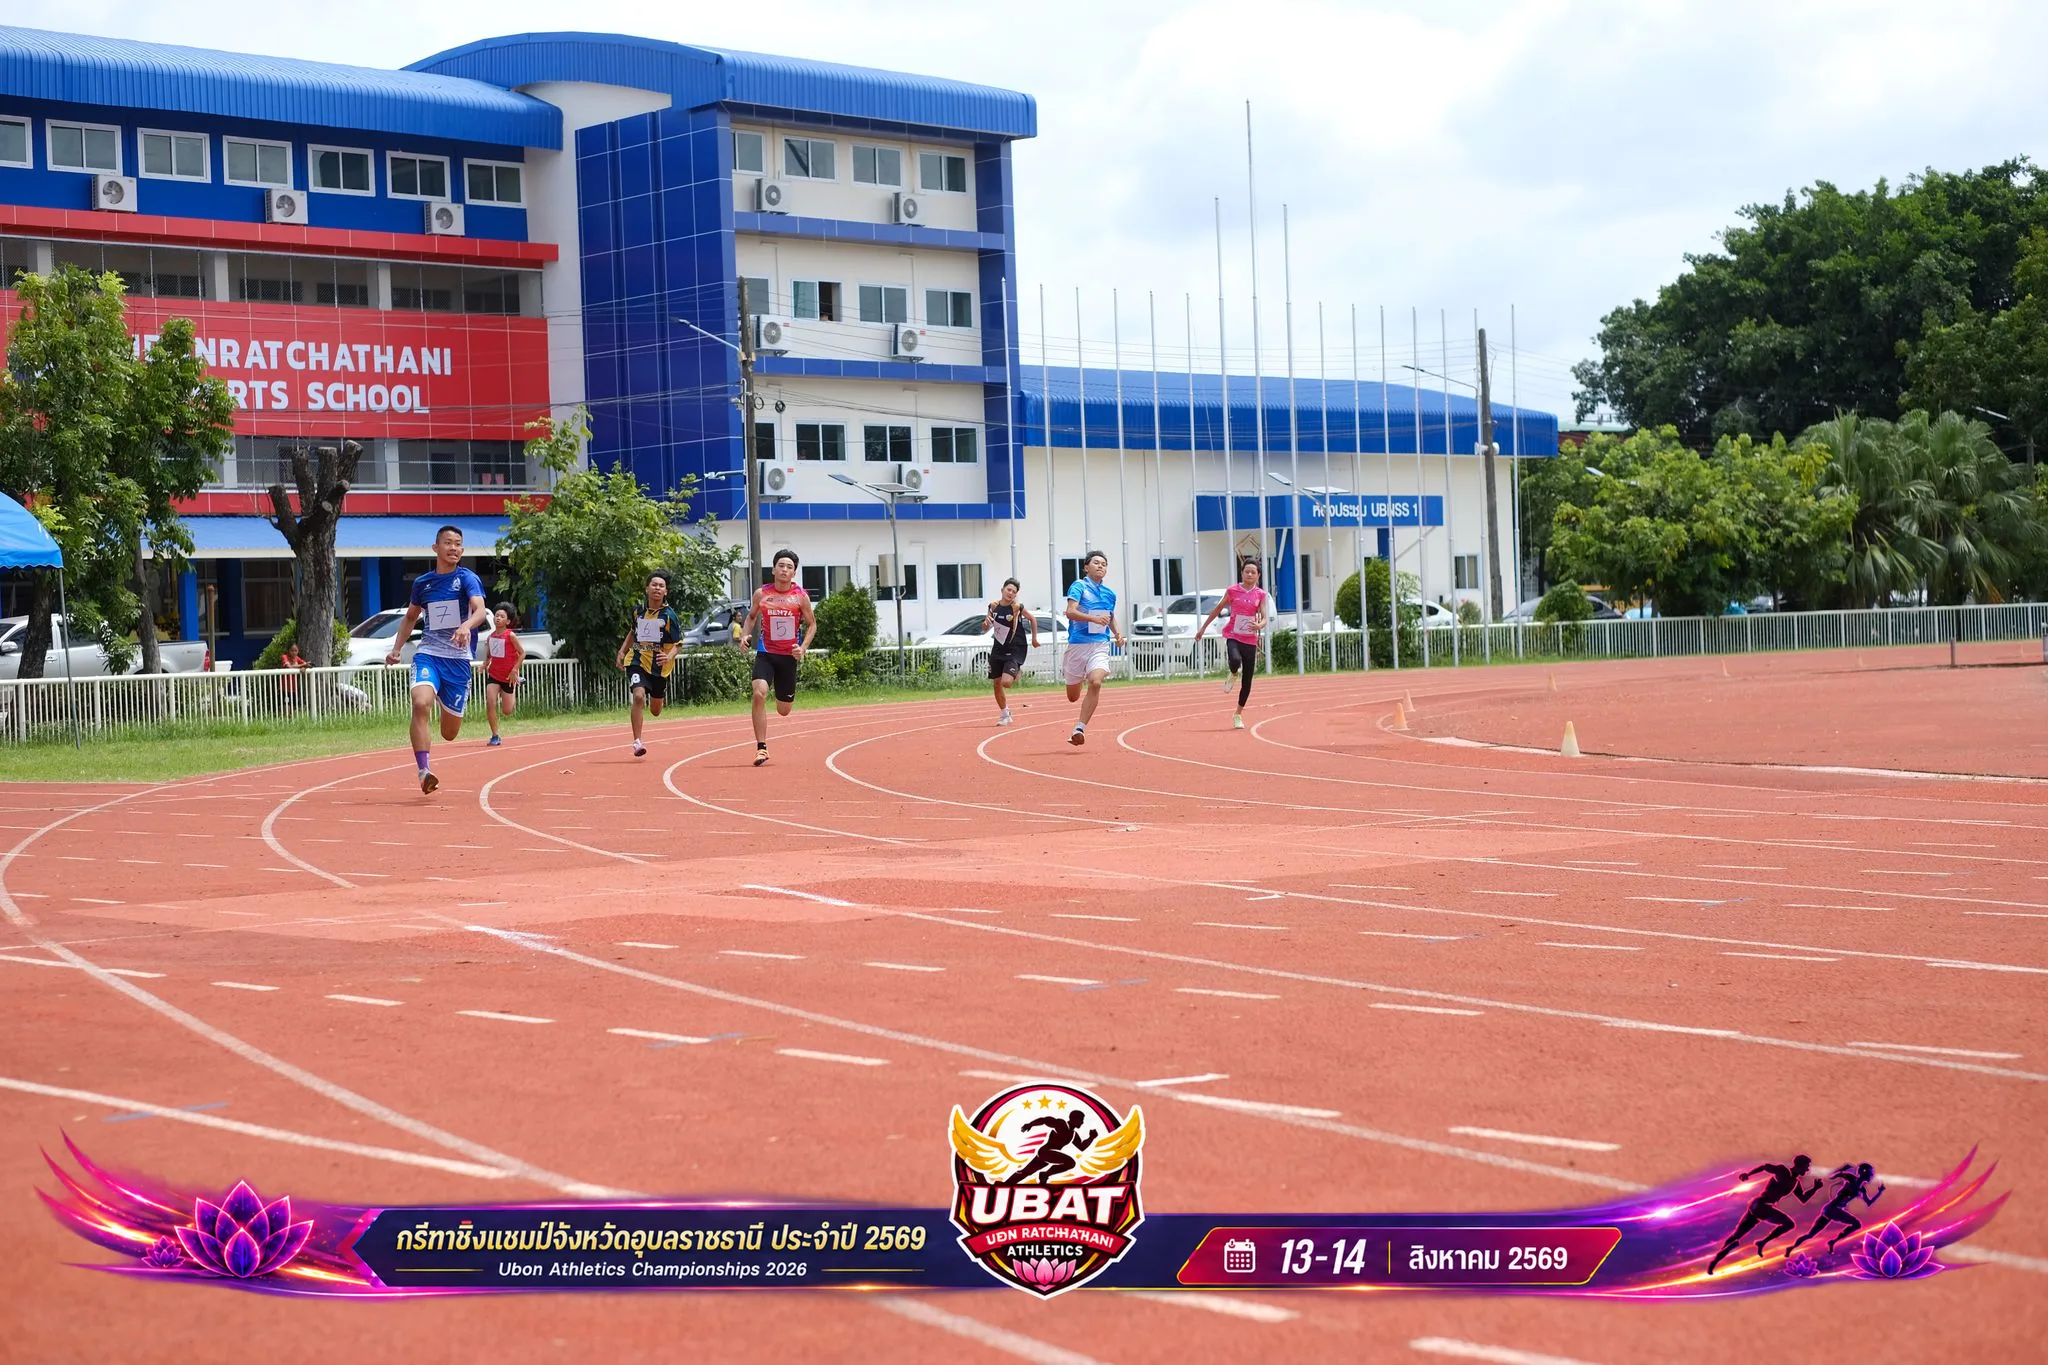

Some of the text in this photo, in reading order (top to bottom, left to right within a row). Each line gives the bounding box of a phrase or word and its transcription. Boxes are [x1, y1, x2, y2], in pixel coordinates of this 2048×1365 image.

[307, 382, 430, 414] SCHOOL
[1412, 503, 1418, 518] 1
[435, 605, 452, 623] 7
[643, 622, 652, 635] 6
[776, 621, 787, 637] 5
[631, 673, 641, 684] 8
[455, 694, 462, 706] 7
